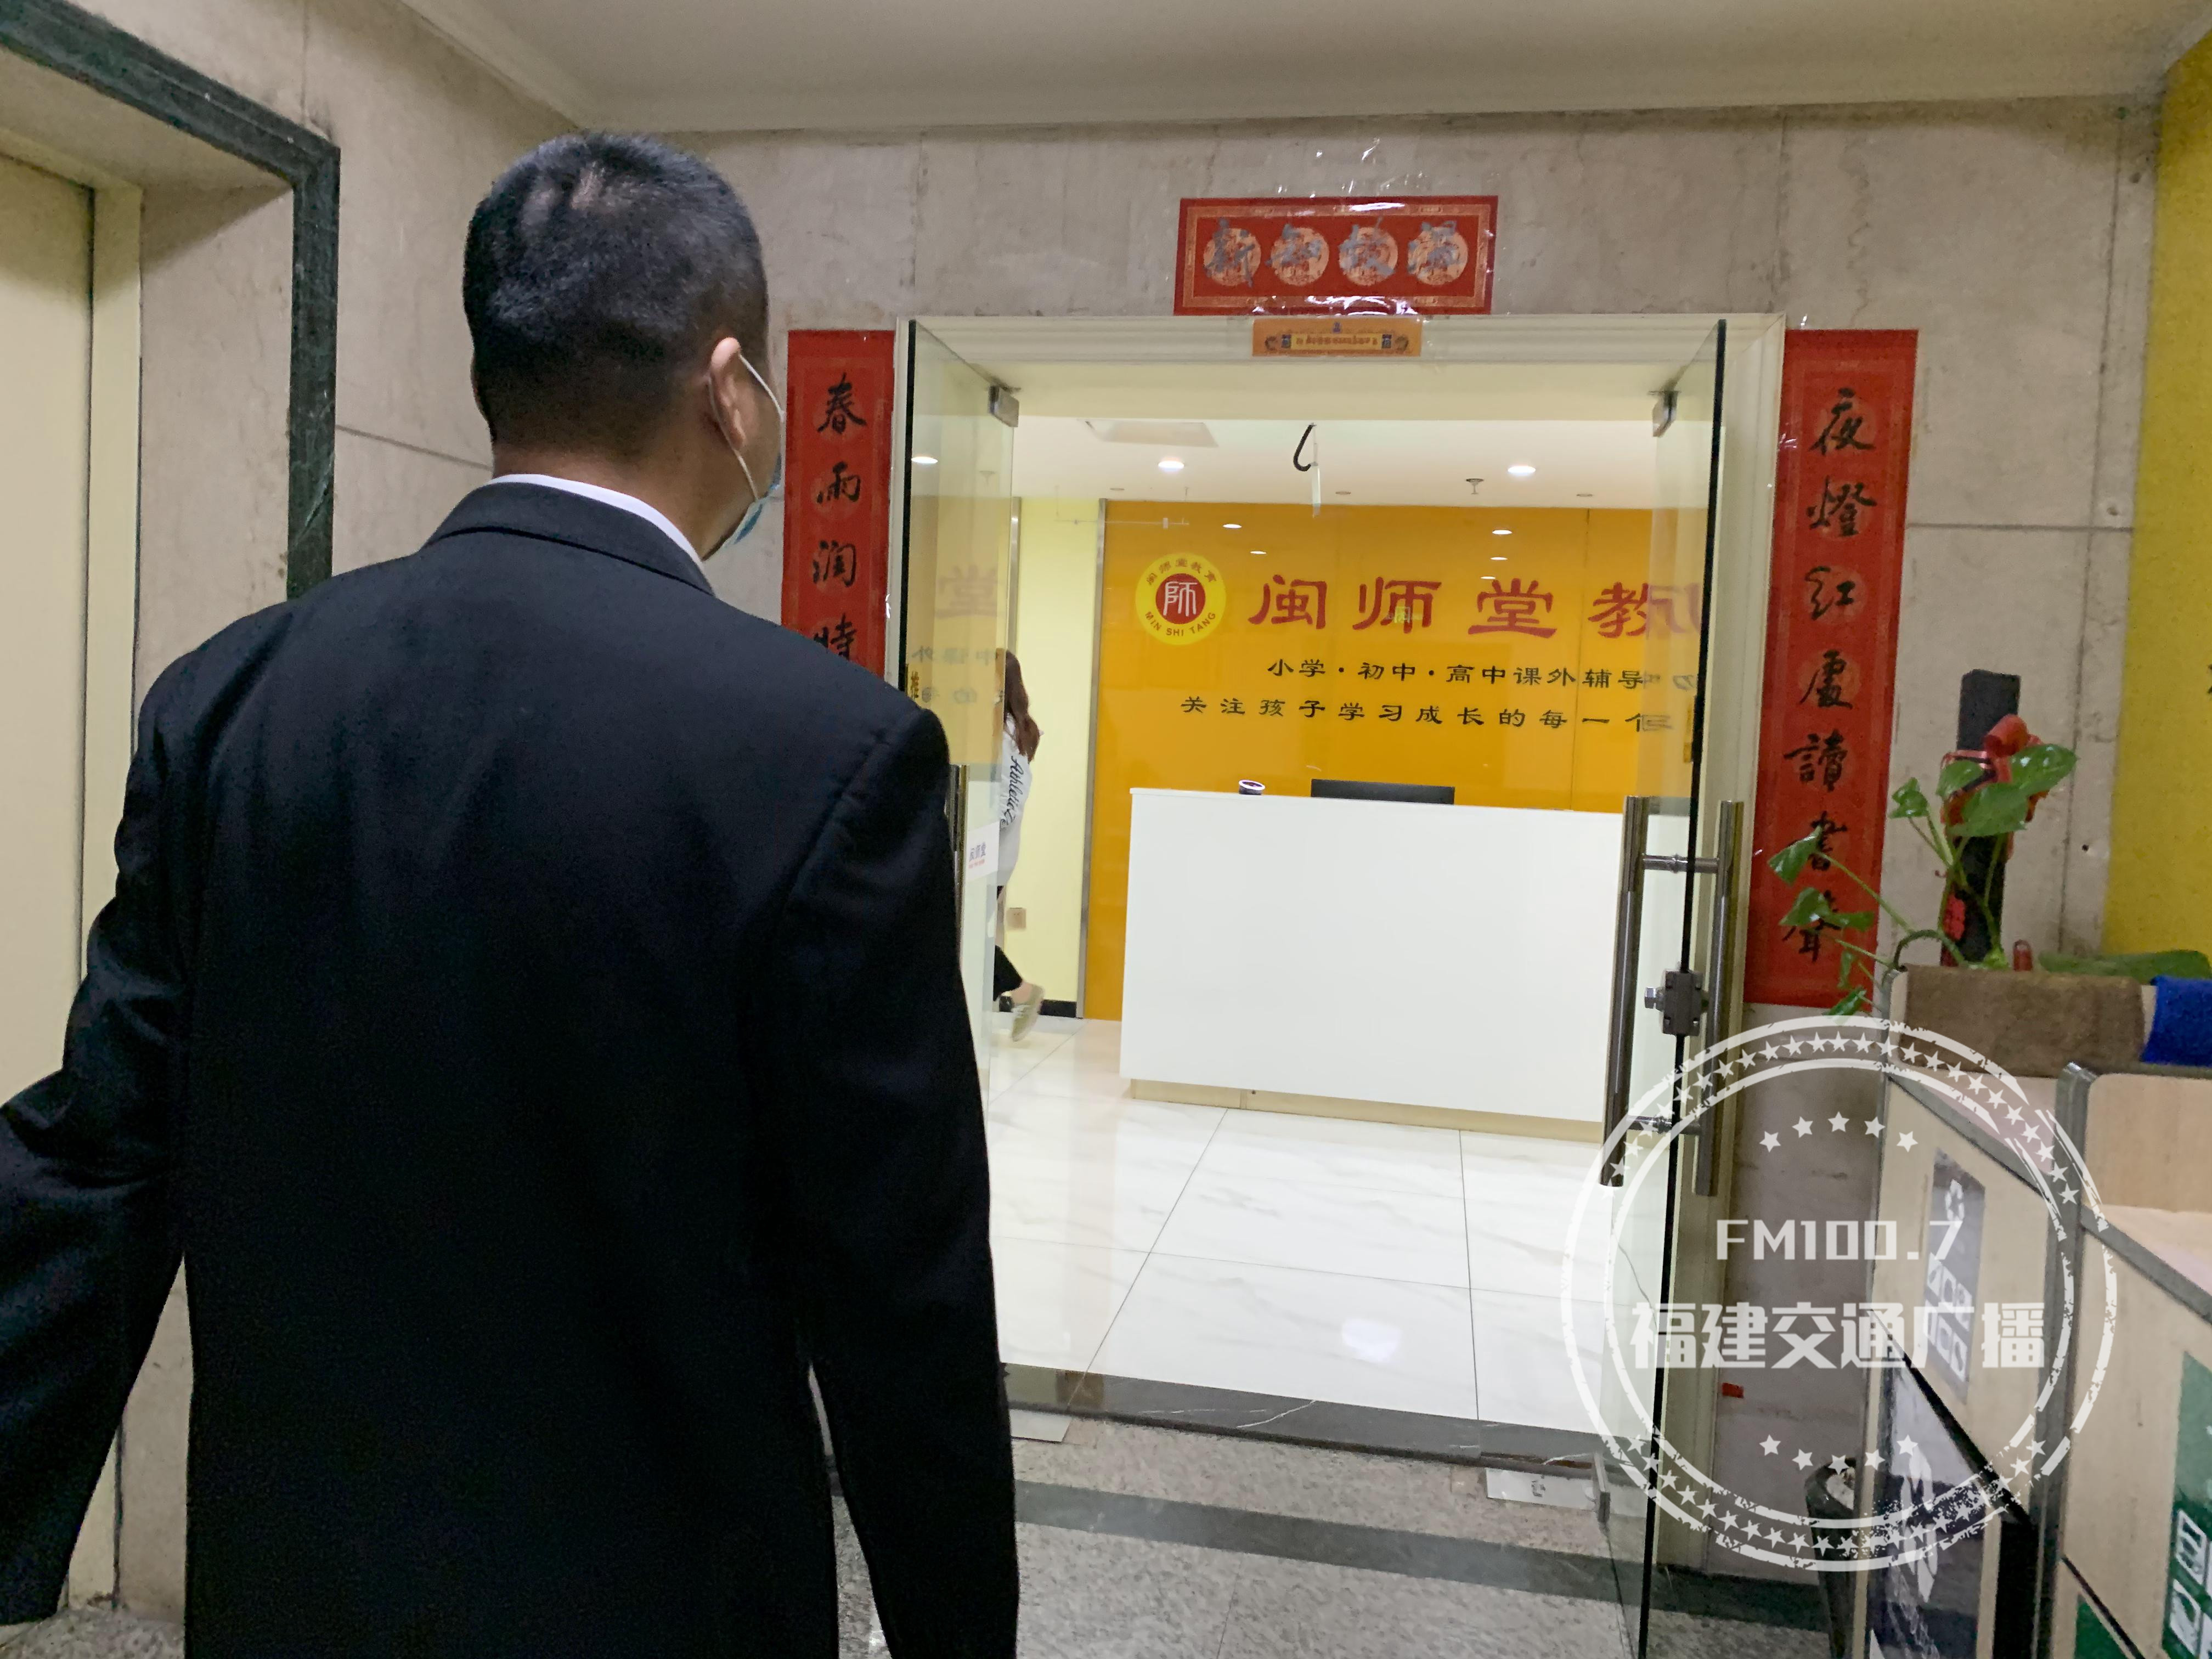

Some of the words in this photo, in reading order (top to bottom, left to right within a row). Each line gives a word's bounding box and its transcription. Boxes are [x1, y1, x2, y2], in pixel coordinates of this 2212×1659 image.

[1145, 612, 1162, 631] MIN
[1166, 628, 1184, 636] SHI
[1189, 613, 1216, 634] TANG
